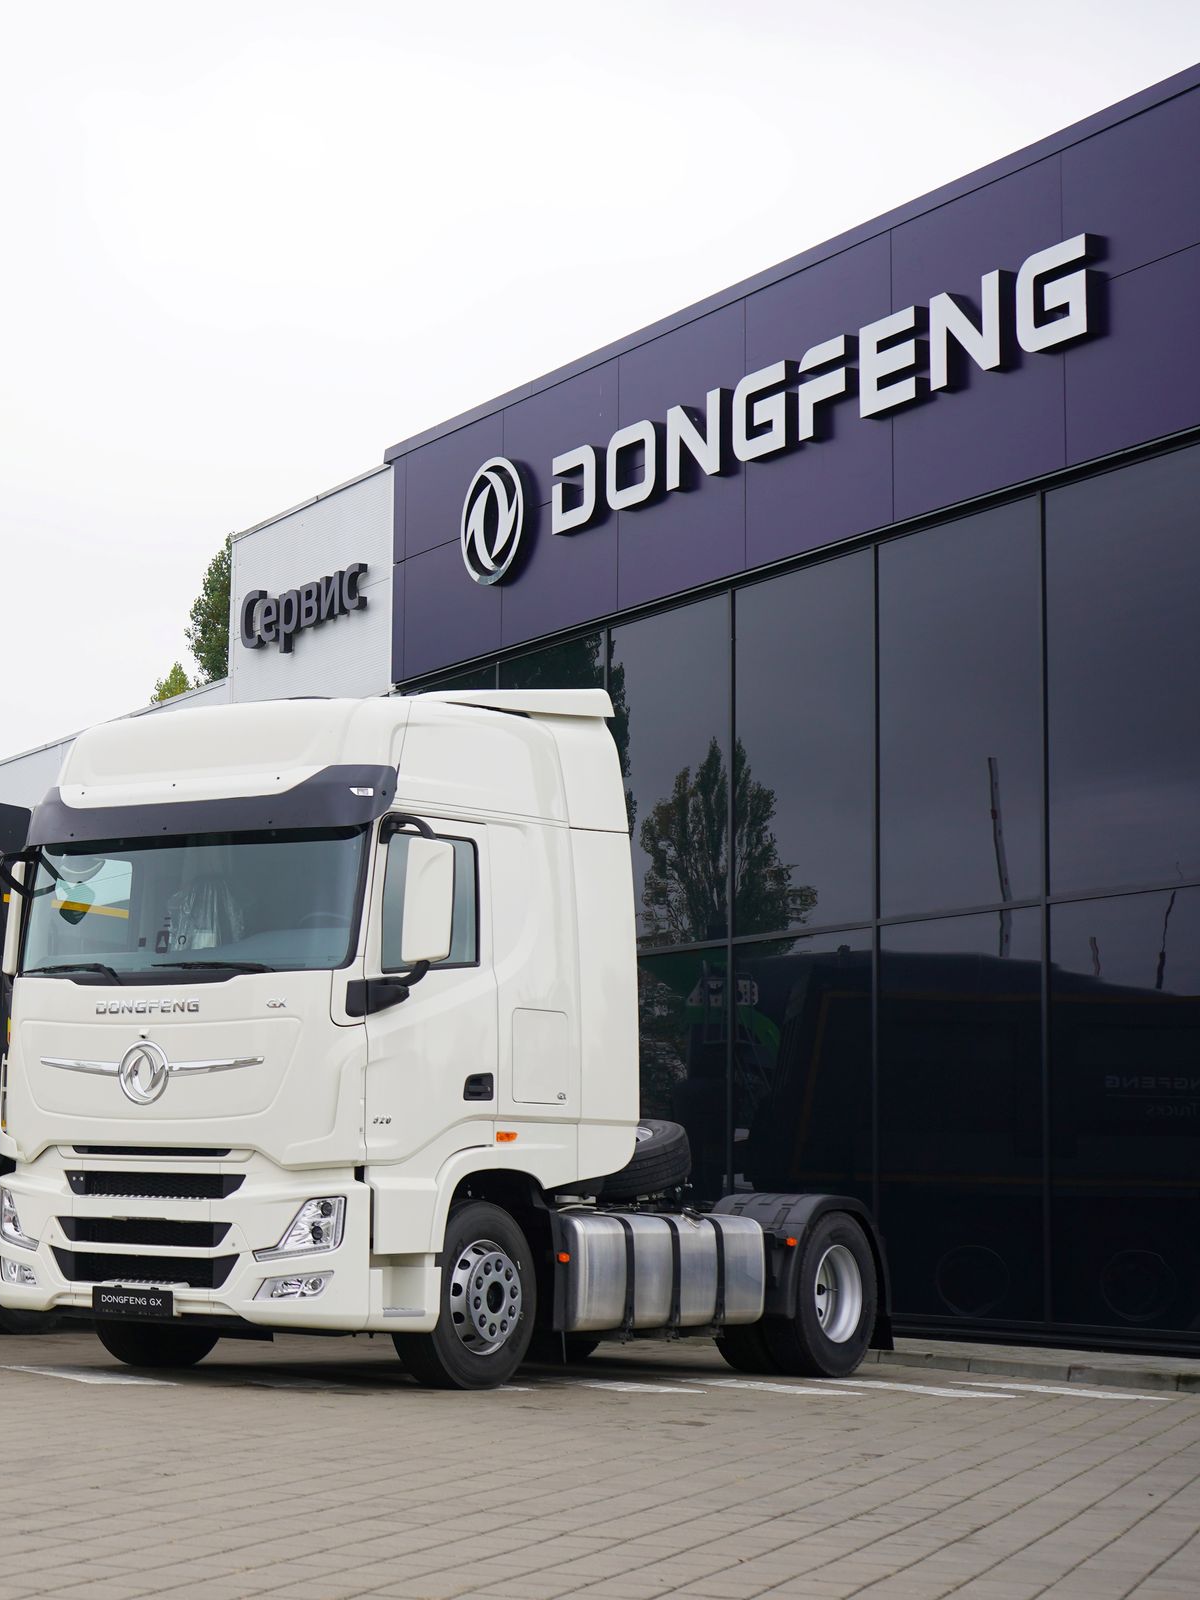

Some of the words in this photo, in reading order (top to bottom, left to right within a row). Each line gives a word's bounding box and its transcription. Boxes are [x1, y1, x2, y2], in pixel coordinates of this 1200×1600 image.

[550, 232, 1096, 536] DONGFENG
[240, 562, 368, 654] Сервис
[95, 999, 200, 1015] DONGFENG
[266, 998, 287, 1009] GX
[101, 1294, 147, 1306] DONGFENG
[149, 1298, 162, 1307] GX
